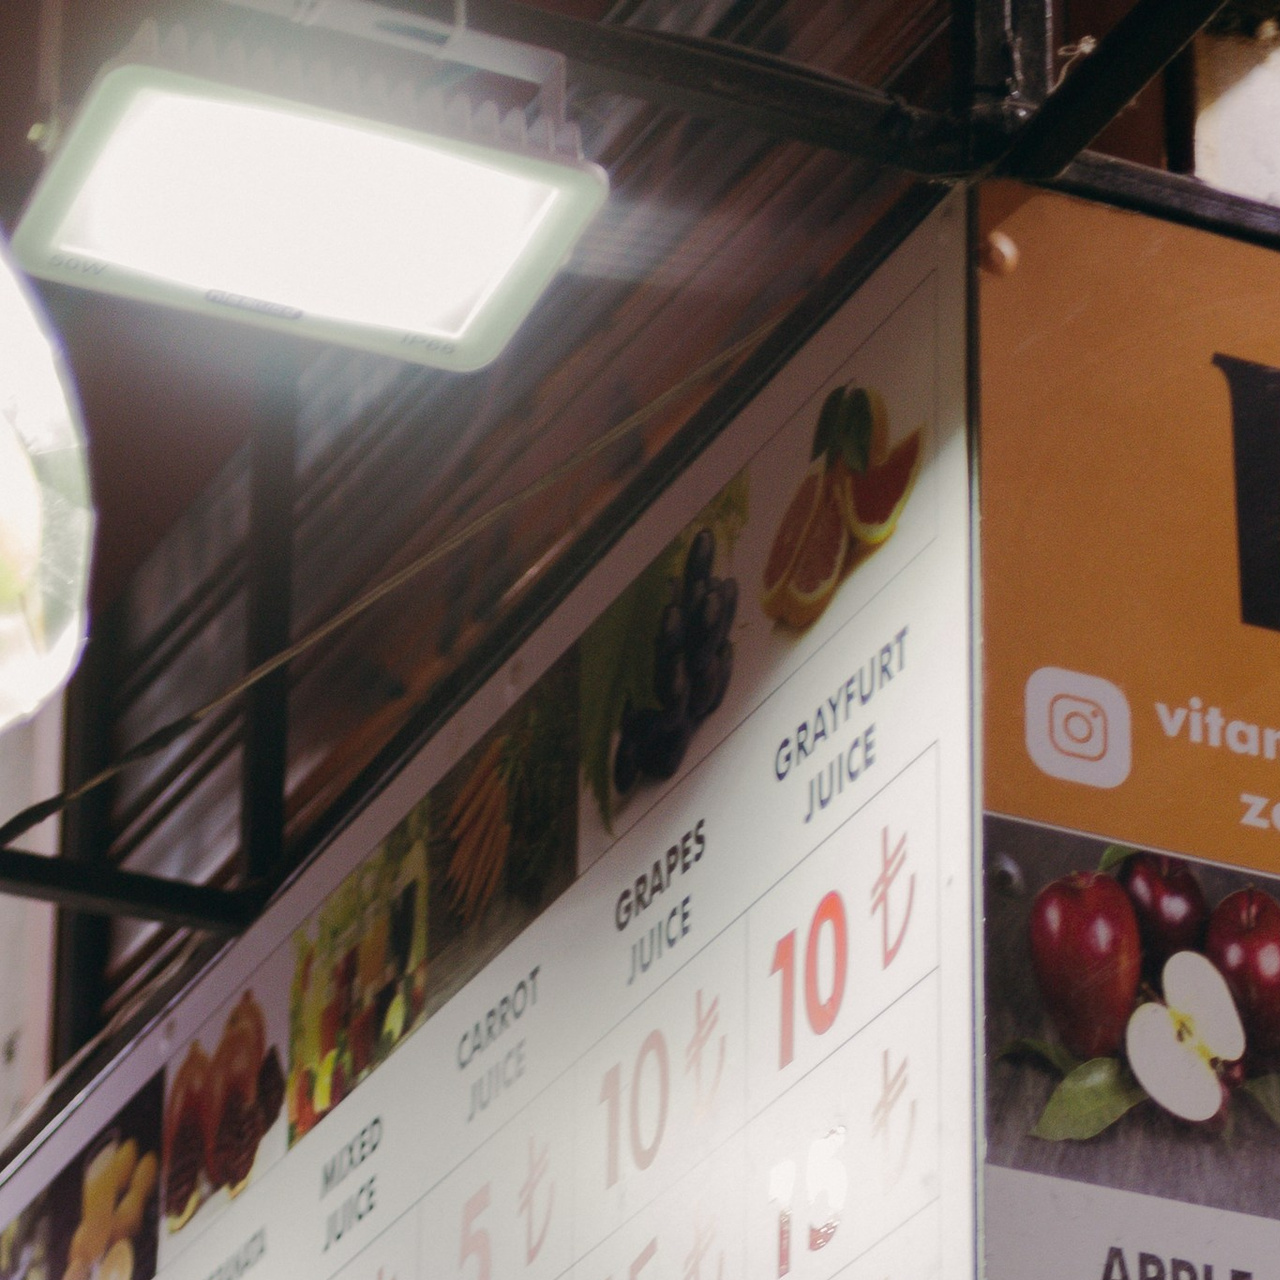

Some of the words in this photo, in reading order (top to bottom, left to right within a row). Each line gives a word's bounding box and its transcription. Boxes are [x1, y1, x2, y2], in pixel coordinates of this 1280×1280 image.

[774, 626, 909, 782] GRAYFURT
[803, 723, 877, 823] JUICE
[614, 819, 706, 932] GRAPES
[627, 894, 692, 986] JUICE
[769, 889, 849, 1071] 10
[457, 965, 540, 1070] CARROT
[467, 1038, 527, 1123] JUICE
[600, 1028, 670, 1190] 10
